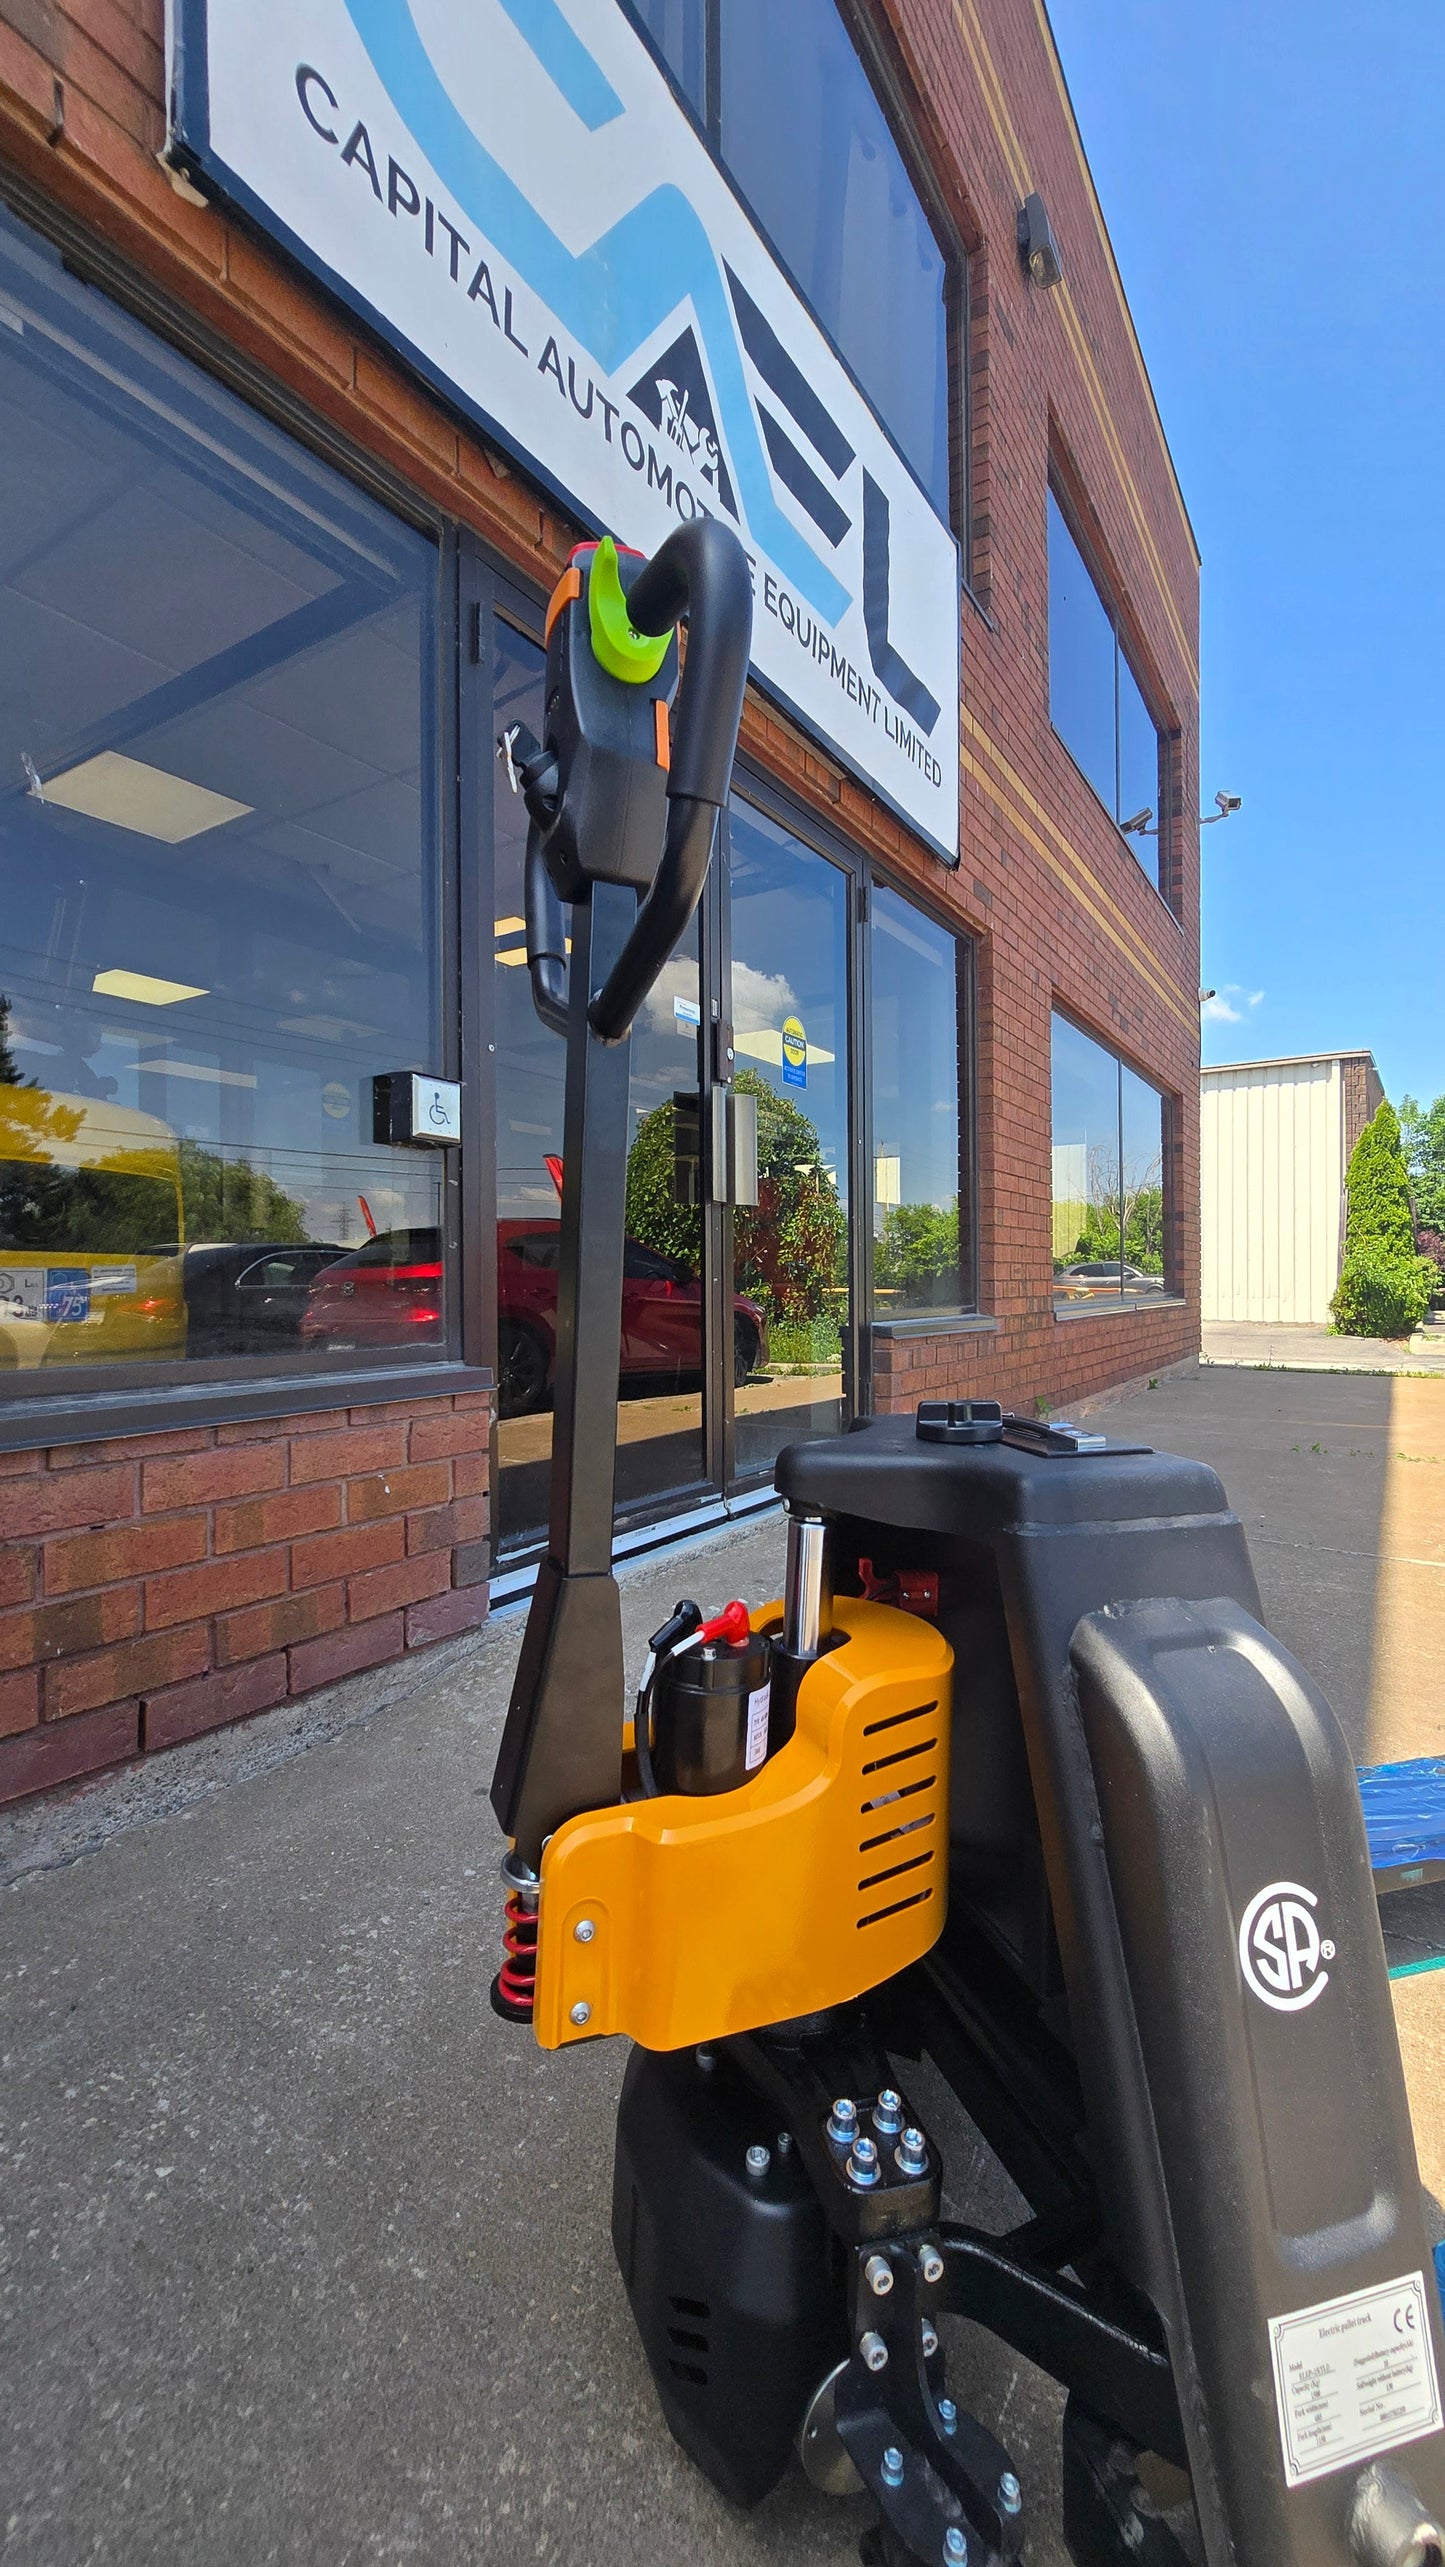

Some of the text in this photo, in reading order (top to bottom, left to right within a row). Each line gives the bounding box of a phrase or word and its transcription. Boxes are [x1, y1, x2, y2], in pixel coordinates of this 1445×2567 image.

[295, 62, 942, 788] CAPITAL AUTOMOE EQUIPMENT LIMITED
[785, 1035, 805, 1050] CAUTION
[1319, 2312, 1372, 2339] Electric pallet truck
[1394, 2304, 1415, 2333] CE
[1289, 2360, 1303, 2373] Model
